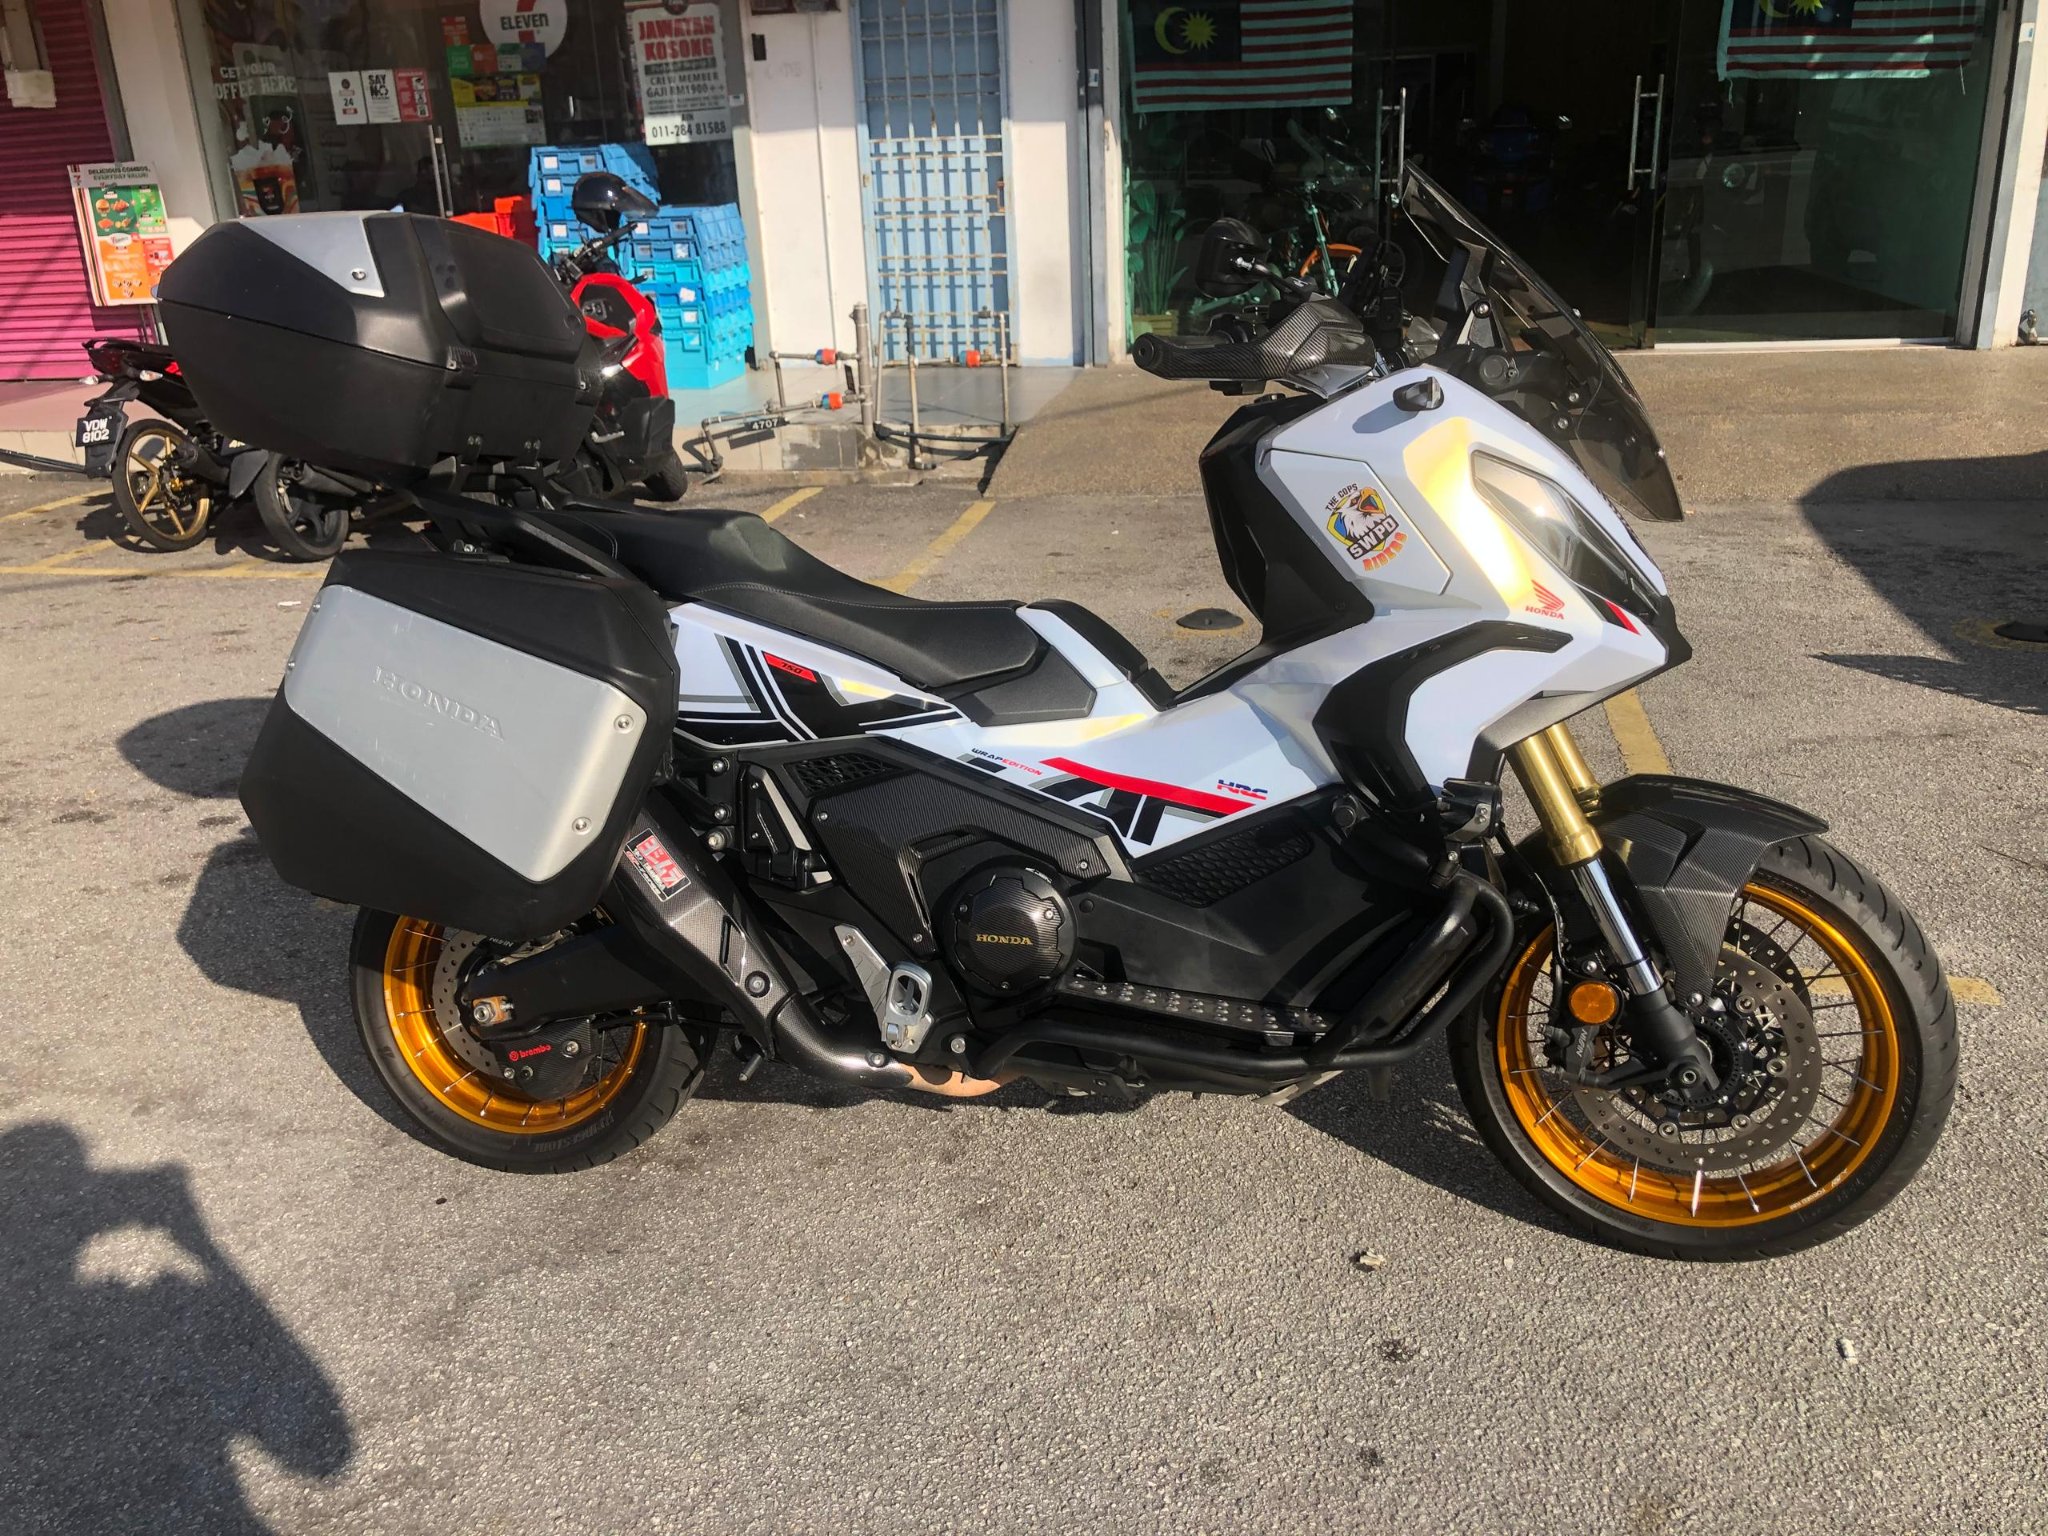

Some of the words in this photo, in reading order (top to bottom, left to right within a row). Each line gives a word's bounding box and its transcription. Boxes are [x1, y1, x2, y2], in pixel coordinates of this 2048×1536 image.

[638, 15, 715, 41] JAWATAN
[644, 37, 714, 61] KOSONG
[242, 62, 277, 77] YOUR
[260, 75, 298, 94] HERE
[368, 74, 387, 85] SAY
[650, 75, 677, 86] CREW
[679, 71, 720, 83] MEMBER
[646, 86, 667, 97] GAJI
[651, 123, 693, 138] 011-284
[83, 418, 108, 432] VDW
[752, 419, 778, 430] 4707
[82, 429, 110, 443] 8102
[1325, 496, 1340, 511] THE
[1338, 483, 1358, 498] COPS
[1348, 516, 1398, 558] SWPD
[1525, 605, 1565, 620] HONDA
[372, 666, 505, 742] HONDA
[1216, 779, 1268, 801] HRC
[975, 933, 1034, 946] HONDA
[519, 1044, 552, 1059] brembo
